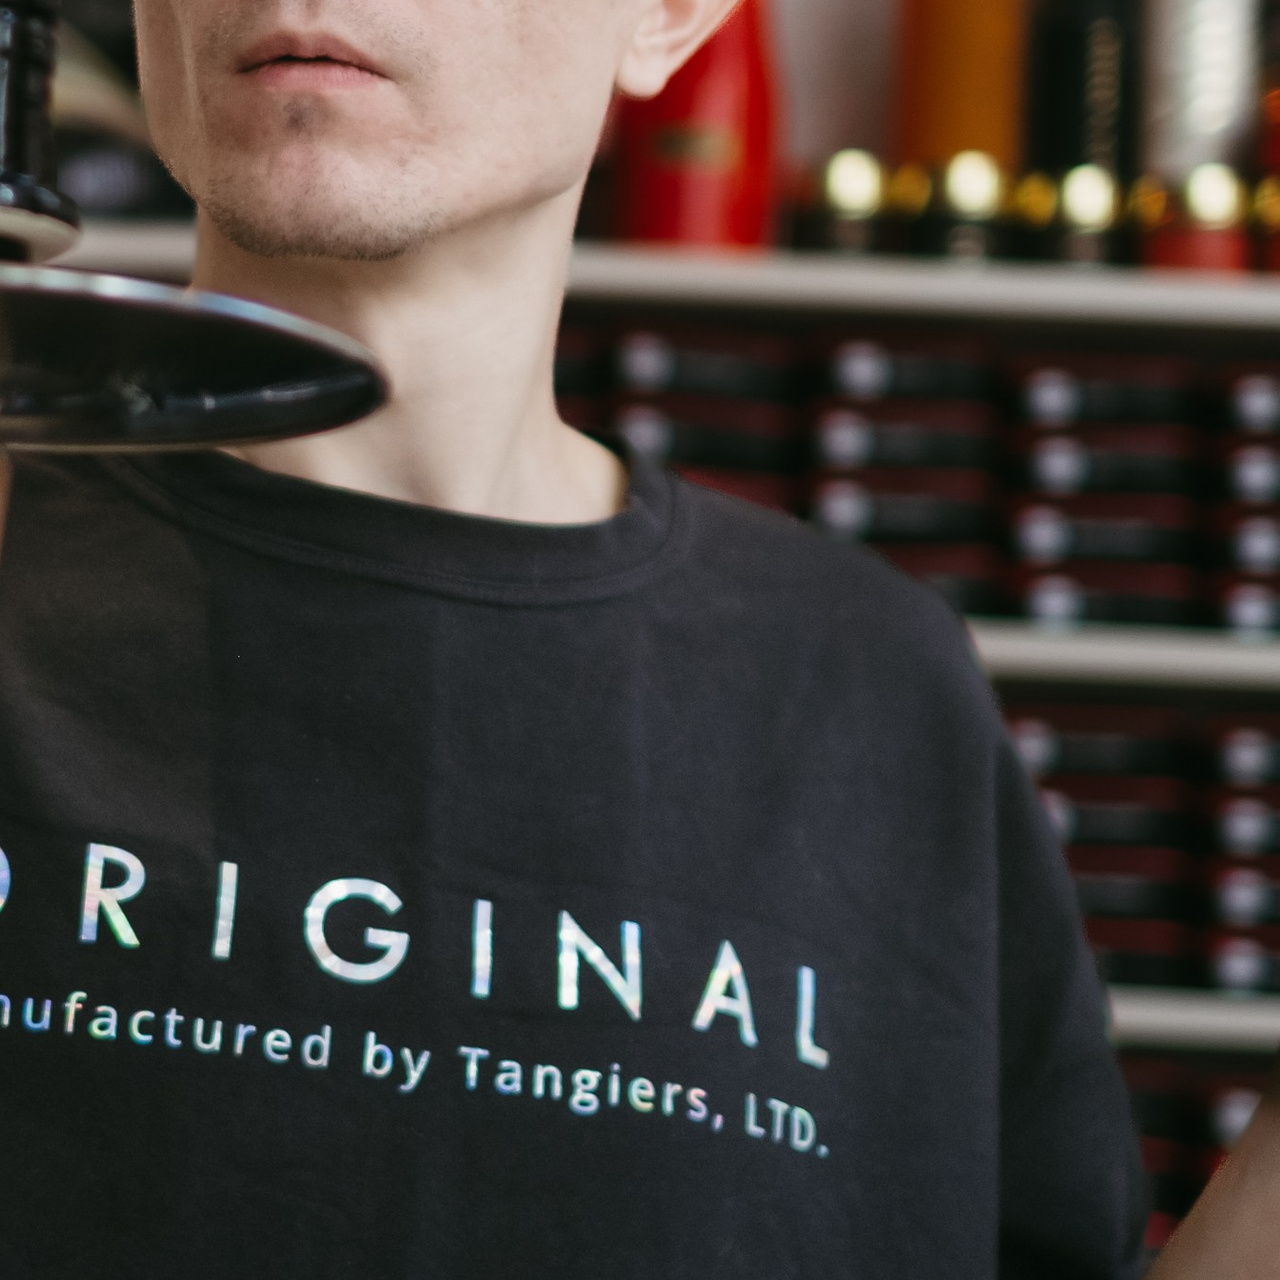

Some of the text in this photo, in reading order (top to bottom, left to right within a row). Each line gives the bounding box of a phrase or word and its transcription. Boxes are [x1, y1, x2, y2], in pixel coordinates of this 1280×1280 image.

[362, 1031, 431, 1092] by
[458, 1044, 724, 1132] Tangiers,
[745, 1092, 829, 1158] LTD.
